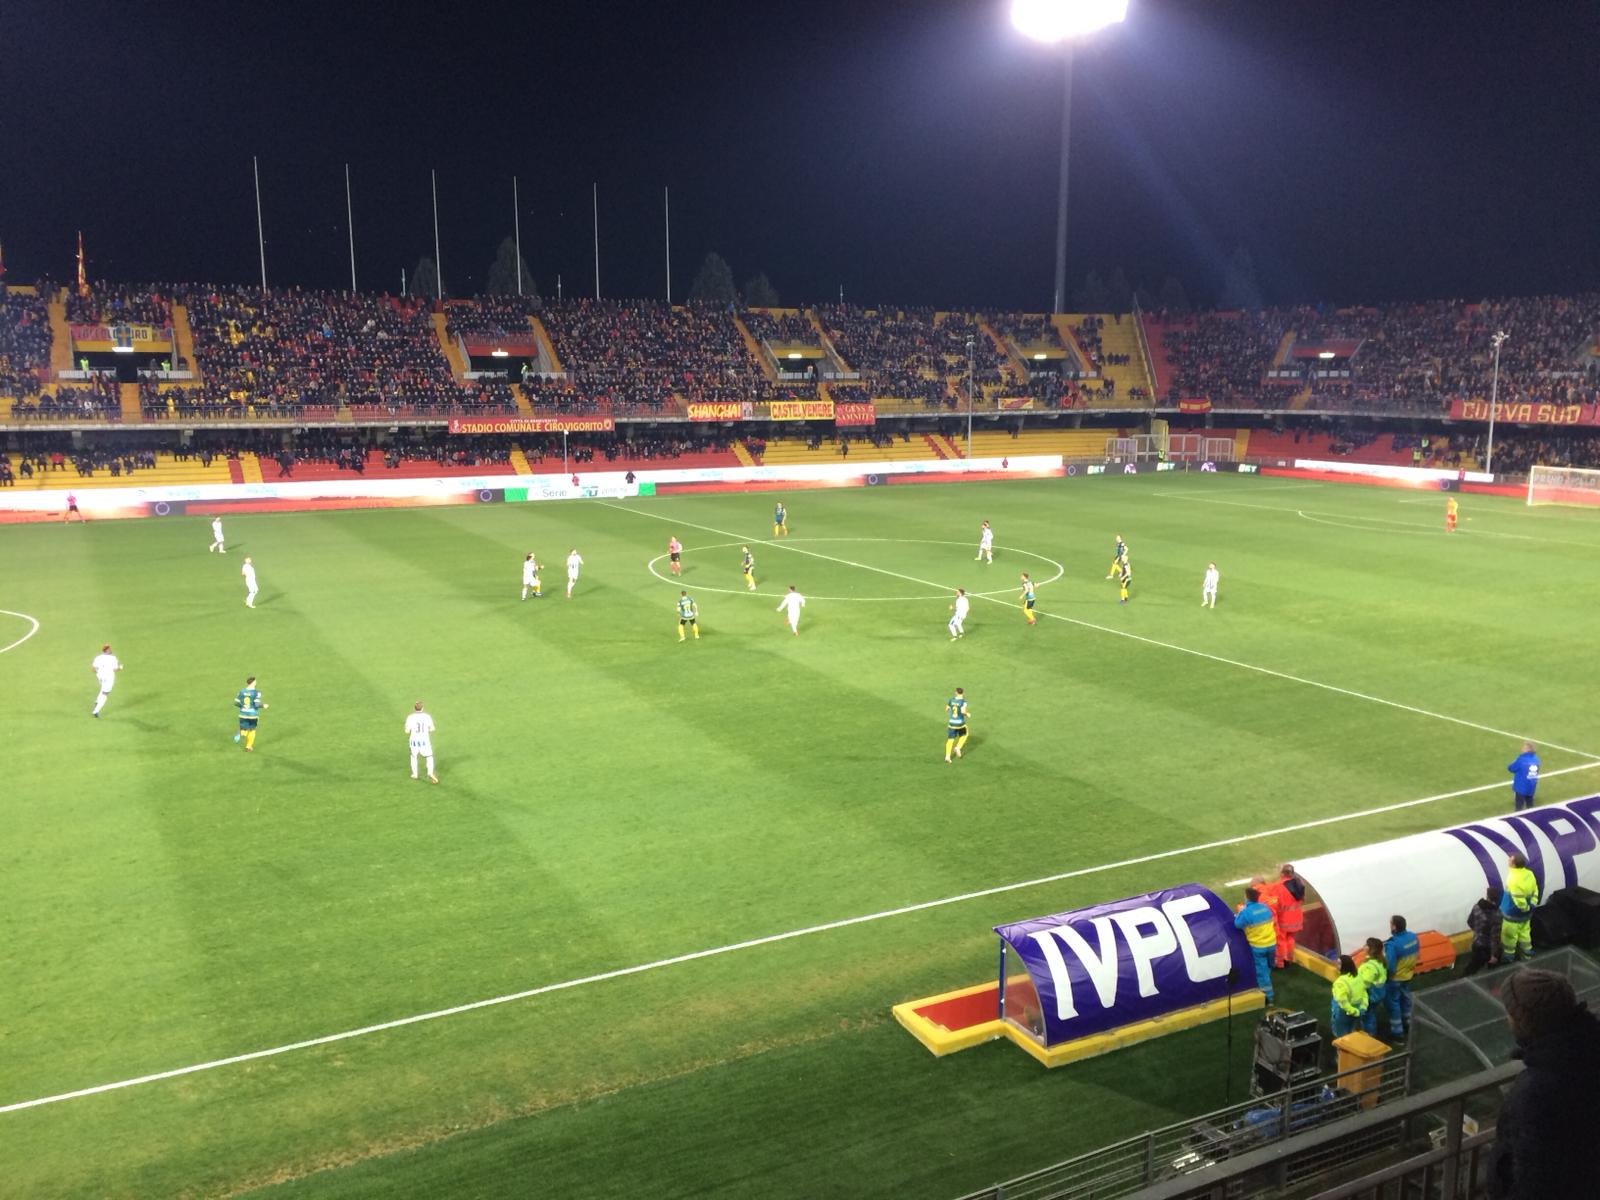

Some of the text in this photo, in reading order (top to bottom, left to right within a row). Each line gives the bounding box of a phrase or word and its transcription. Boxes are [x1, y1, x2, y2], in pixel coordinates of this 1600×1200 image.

[687, 403, 741, 419] SHANGHAI
[1462, 402, 1581, 424] CURVA SUD
[461, 421, 603, 433] STADIO COMUNALE CIRO VIGORITO
[543, 488, 567, 497] Serie
[1027, 893, 1232, 1021] IVPC
